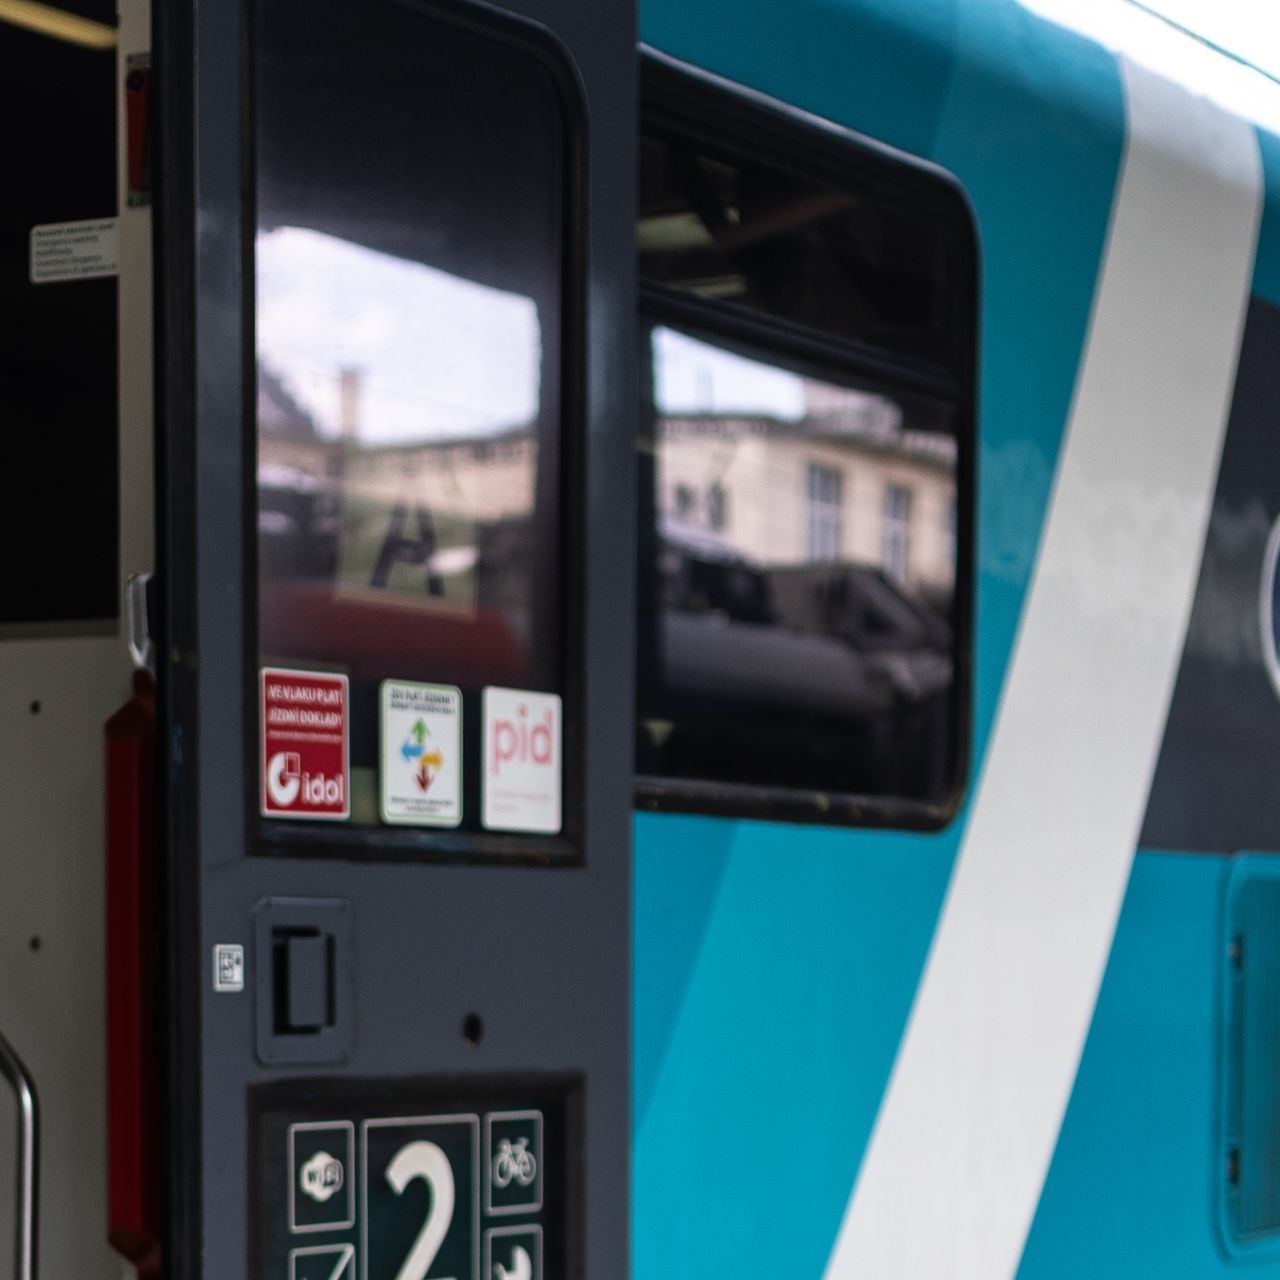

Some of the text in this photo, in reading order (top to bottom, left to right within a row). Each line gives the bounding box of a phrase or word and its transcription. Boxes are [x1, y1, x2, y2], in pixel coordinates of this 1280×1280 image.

[283, 685, 316, 700] VLAKU
[492, 704, 553, 777] pid
[302, 771, 344, 804] idol
